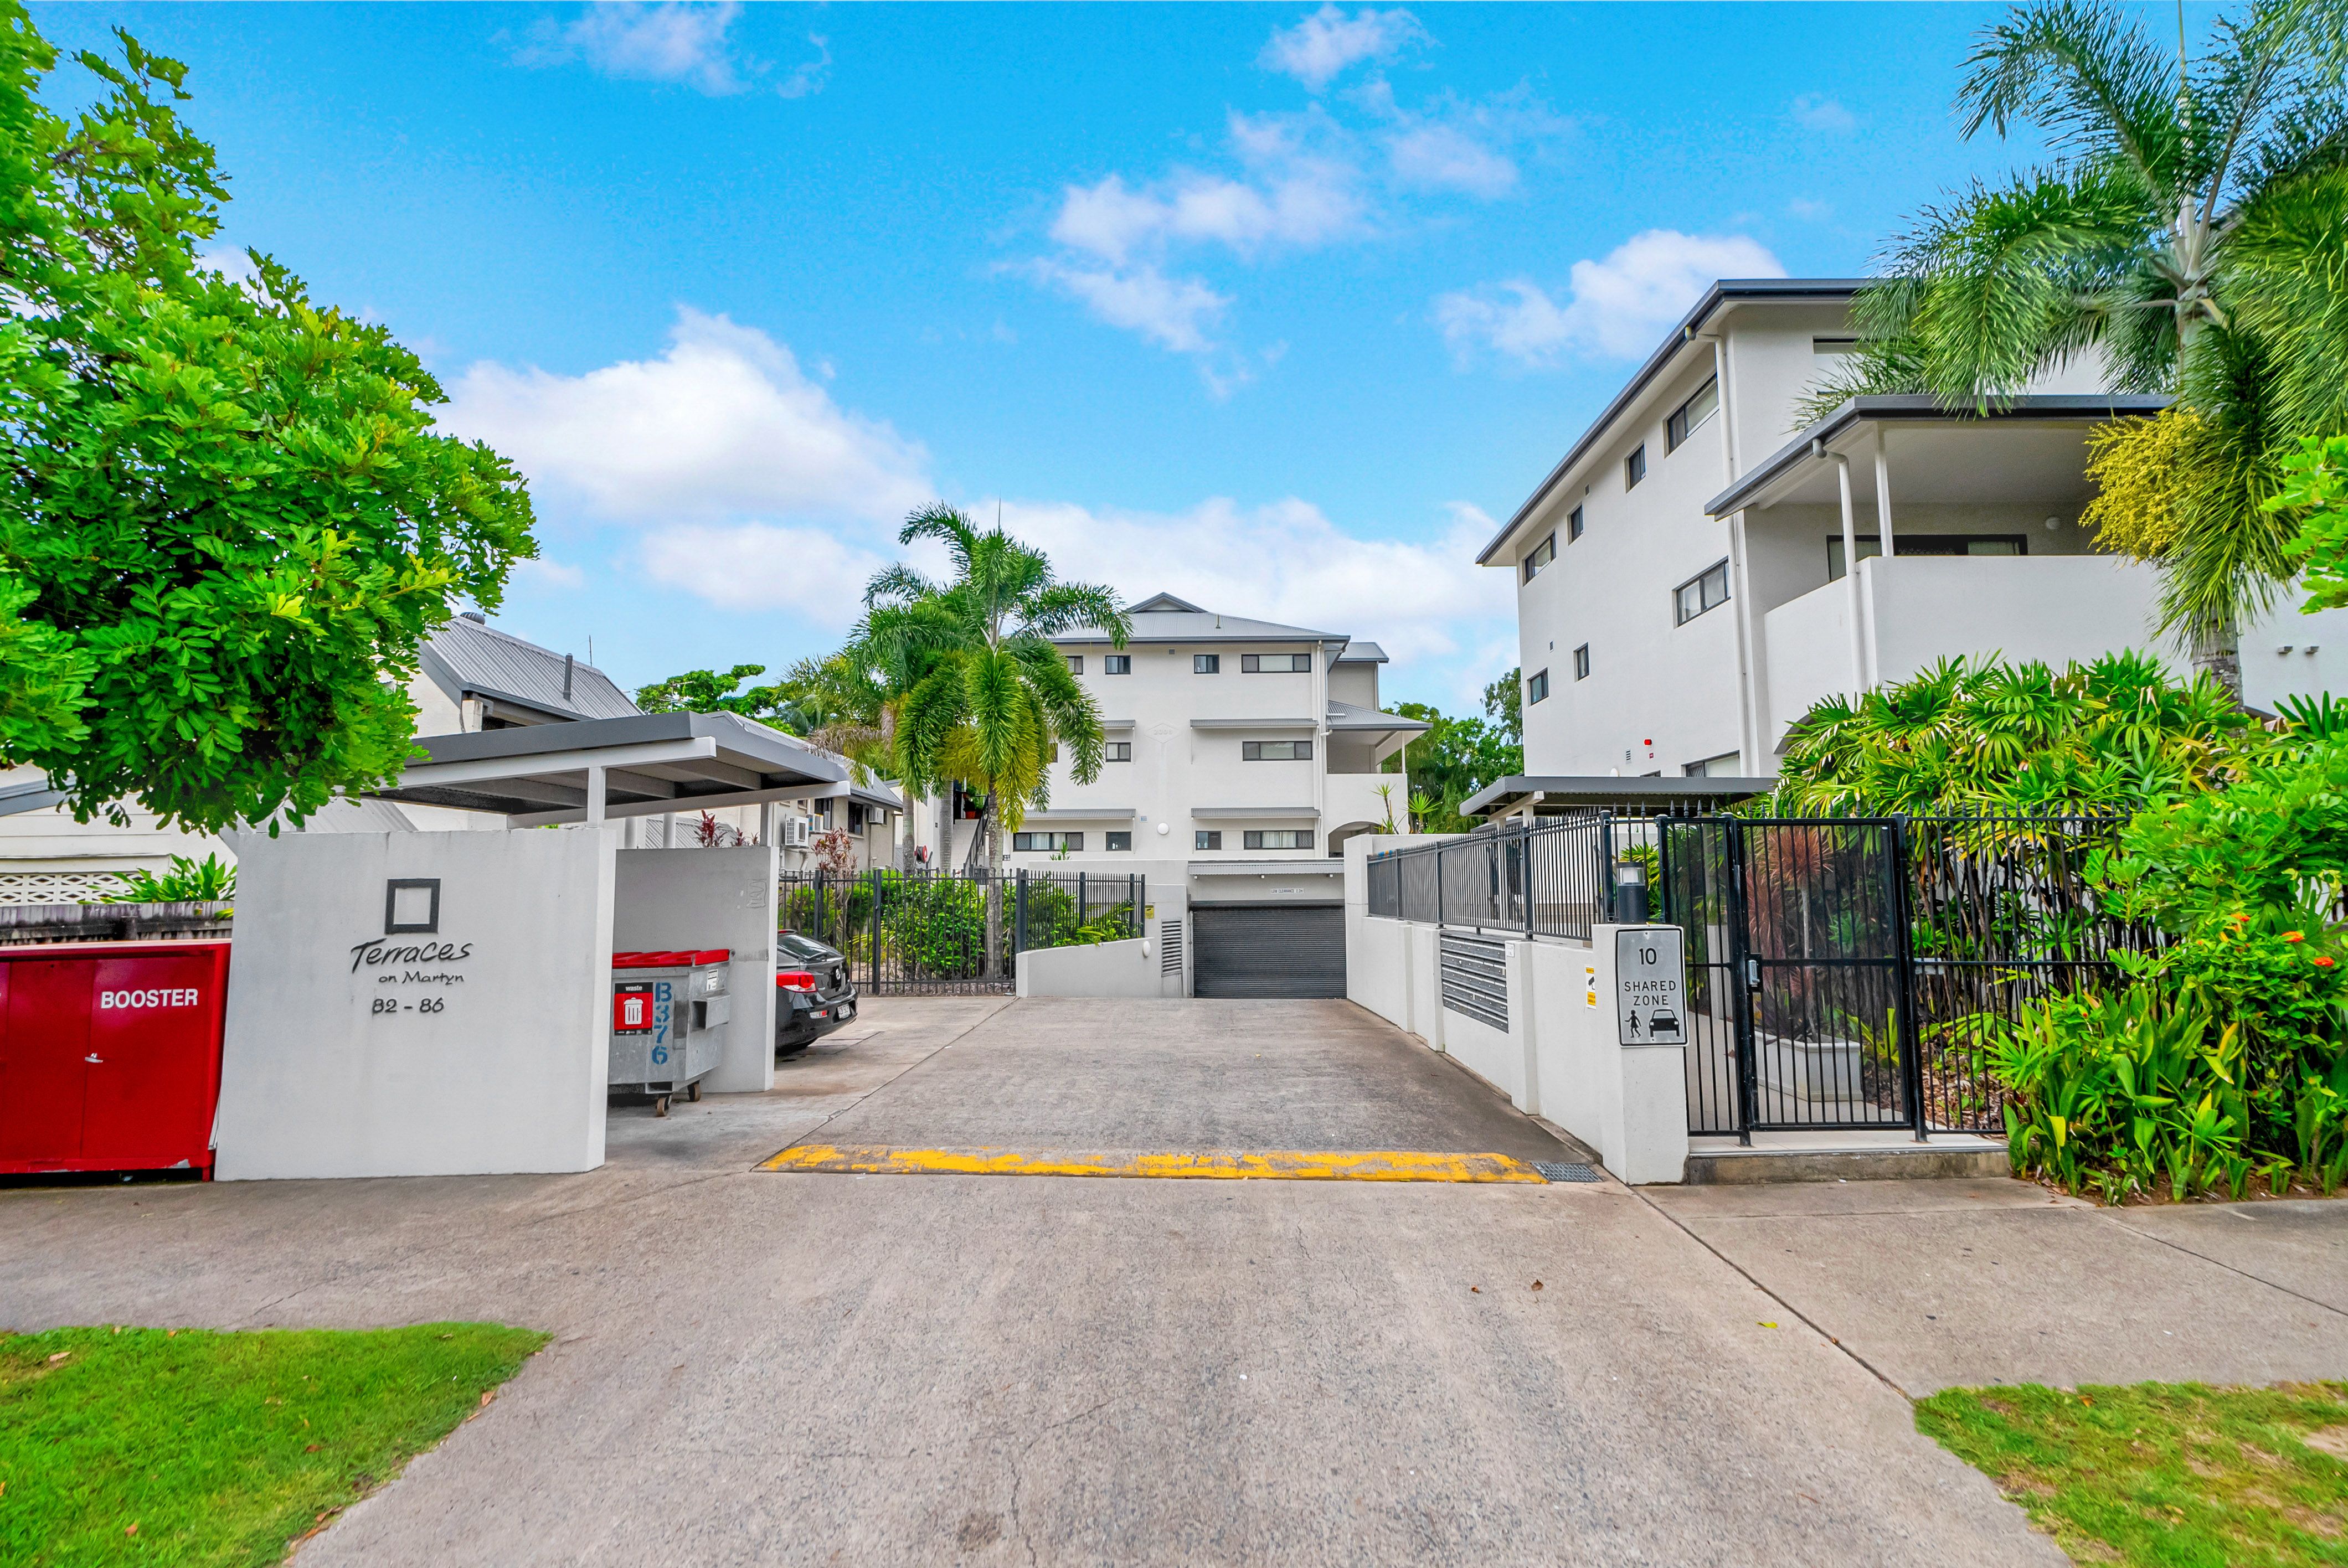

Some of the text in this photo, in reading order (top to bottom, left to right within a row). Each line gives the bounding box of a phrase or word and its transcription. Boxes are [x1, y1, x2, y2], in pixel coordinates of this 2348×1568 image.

[351, 938, 473, 974] Terraces
[1639, 948, 1657, 965] 10
[402, 971, 464, 985] Martyn
[1624, 980, 1676, 992] SHARED
[101, 988, 198, 1009] BOOSTER
[372, 998, 397, 1014] 82
[419, 997, 444, 1013] 86
[1633, 995, 1669, 1006] ZONE
